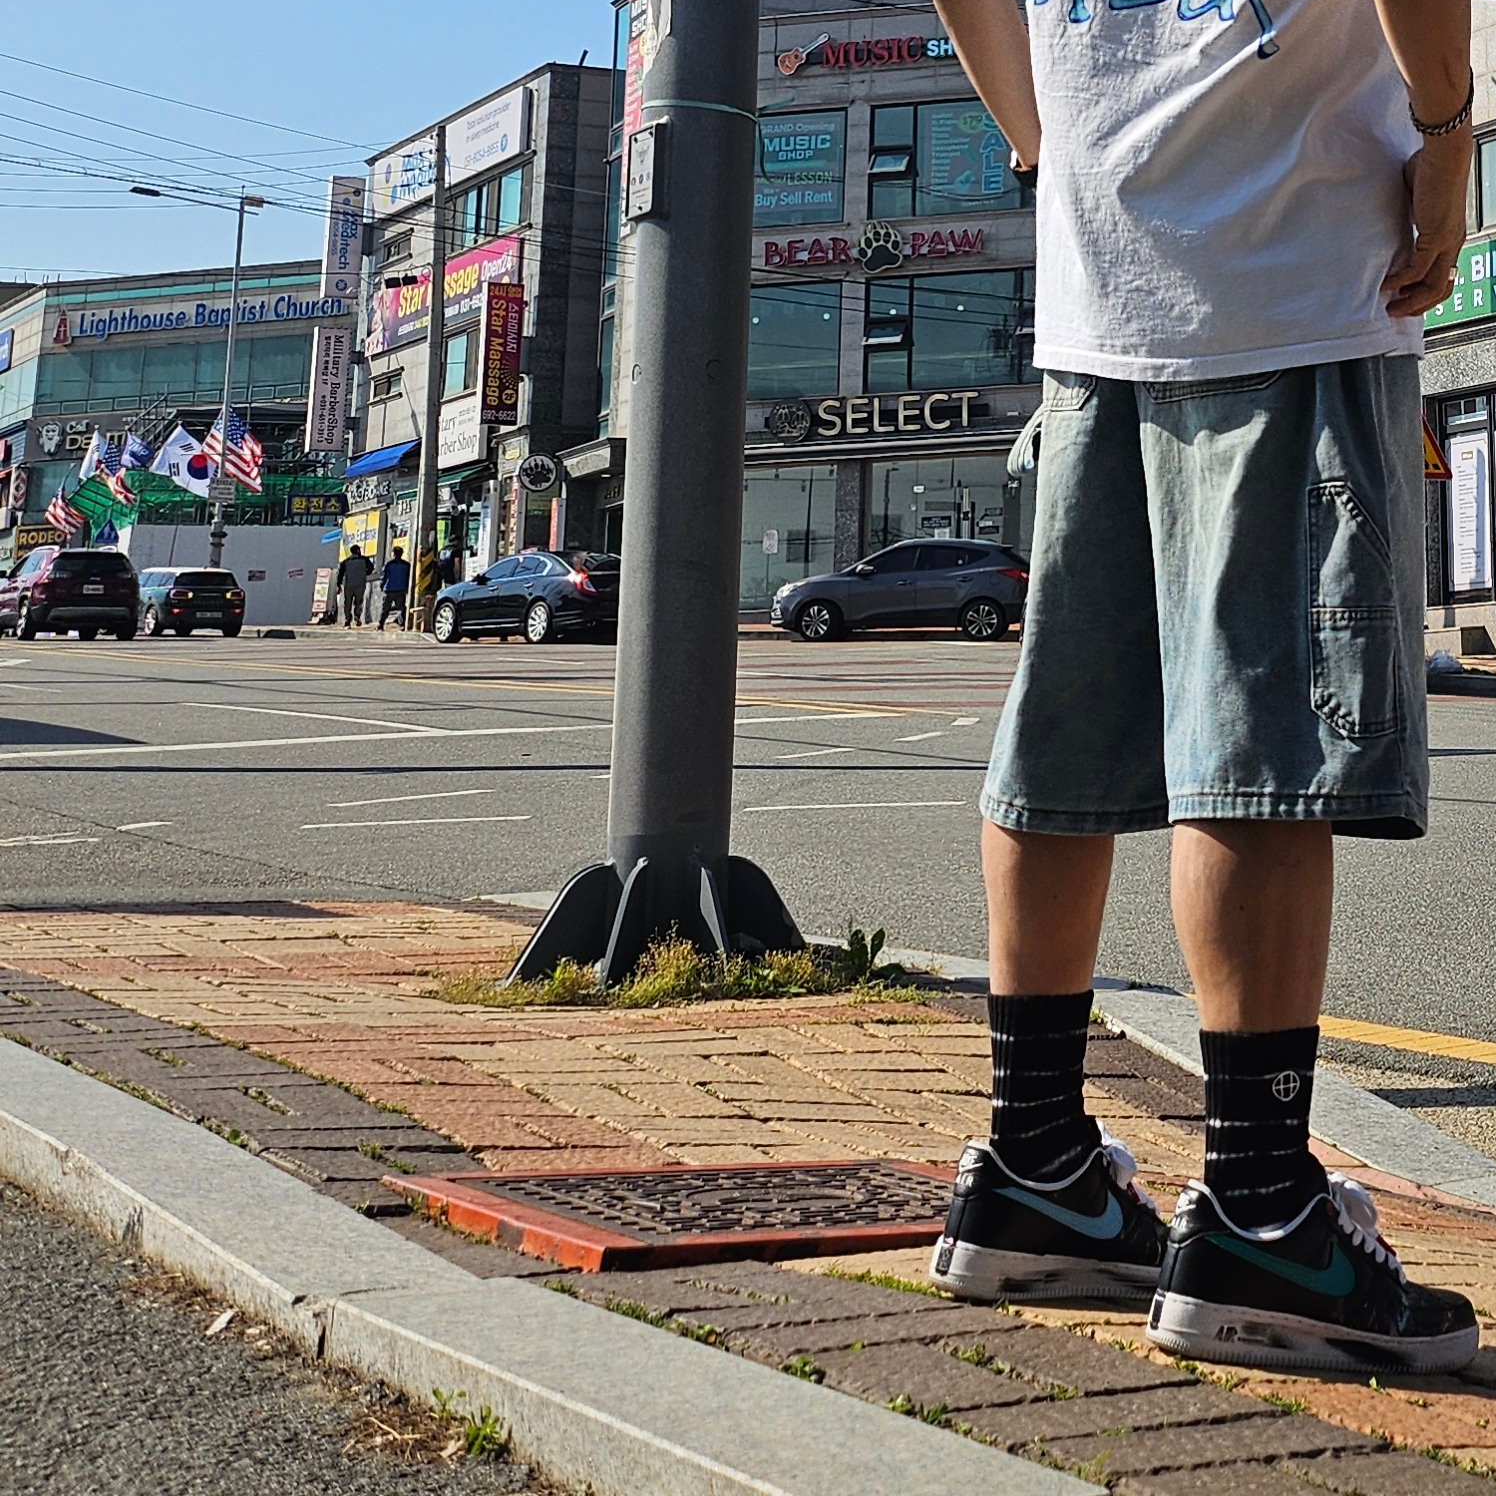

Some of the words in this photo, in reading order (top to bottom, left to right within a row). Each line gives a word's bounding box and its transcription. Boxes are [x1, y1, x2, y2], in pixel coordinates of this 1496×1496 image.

[821, 36, 924, 69] MUSIC
[764, 134, 832, 153] MUSIC
[778, 150, 814, 160] SHOP
[755, 193, 778, 209] Buy
[780, 191, 802, 206] Sell
[805, 190, 833, 204] Rent
[764, 237, 855, 267] BEAR
[909, 228, 985, 259] PAW
[79, 307, 187, 340] Lighthouse
[273, 294, 343, 320] Church
[398, 286, 425, 318] Star
[490, 299, 507, 333] Star
[330, 335, 344, 379] Military
[486, 337, 504, 406] Massage
[504, 392, 515, 402] 2F
[817, 391, 979, 437] SELECT
[19, 529, 65, 545] RODEO
[955, 1172, 974, 1187] AIR
